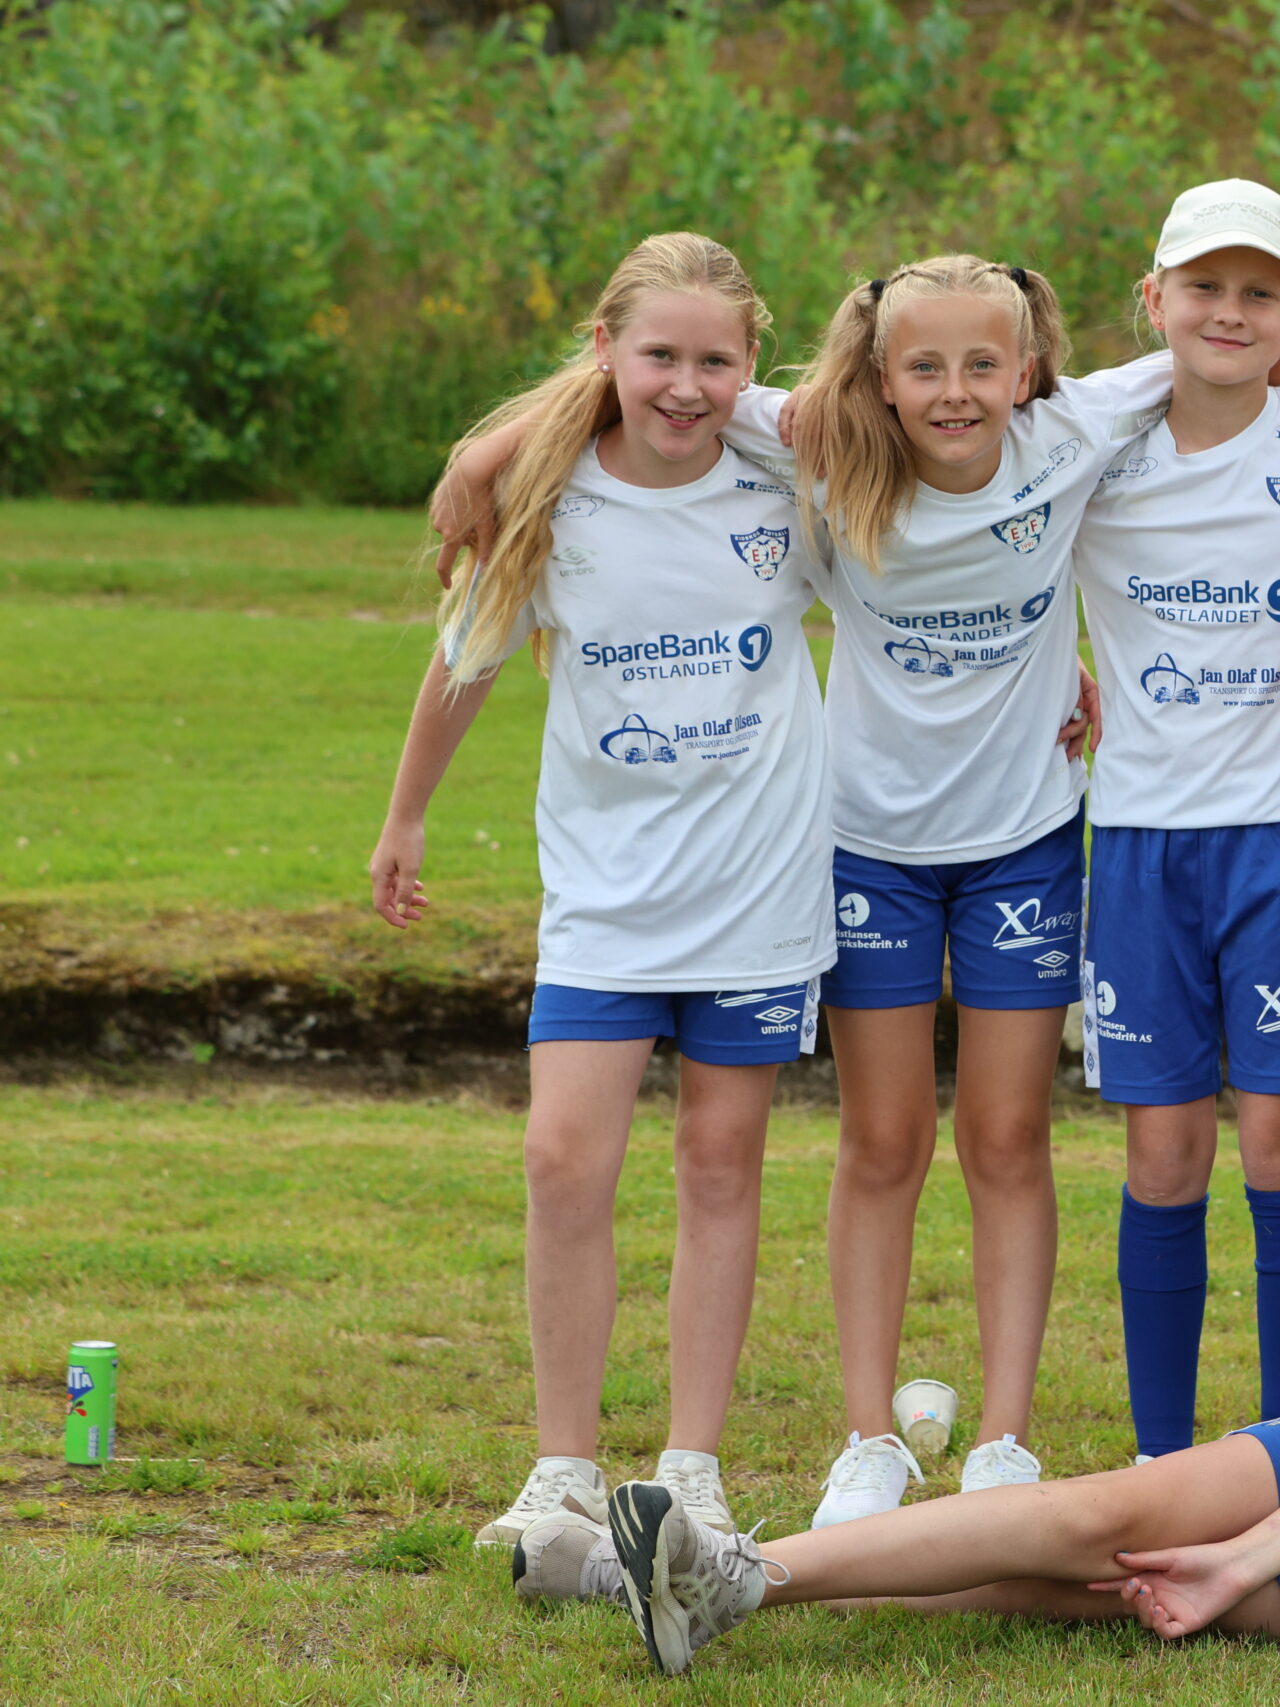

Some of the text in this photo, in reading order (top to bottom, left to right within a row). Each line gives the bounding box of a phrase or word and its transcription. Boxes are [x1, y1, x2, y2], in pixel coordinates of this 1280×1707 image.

[1010, 519, 1038, 540] E F
[751, 546, 778, 562] E F
[1127, 575, 1260, 605] SpareBank
[1155, 608, 1261, 623] ØSTLANDET
[581, 630, 731, 667] SpareBank
[952, 645, 1008, 662] Jan Olaf
[622, 659, 733, 682] ØSTLANDET
[1198, 668, 1223, 685] Jan
[1227, 668, 1257, 684] Olaf
[673, 713, 762, 743] Jan Olaf Olsen
[895, 940, 908, 949] AS
[1038, 968, 1067, 979] umbro
[761, 1023, 797, 1035] umbro
[1138, 1033, 1153, 1043] AS
